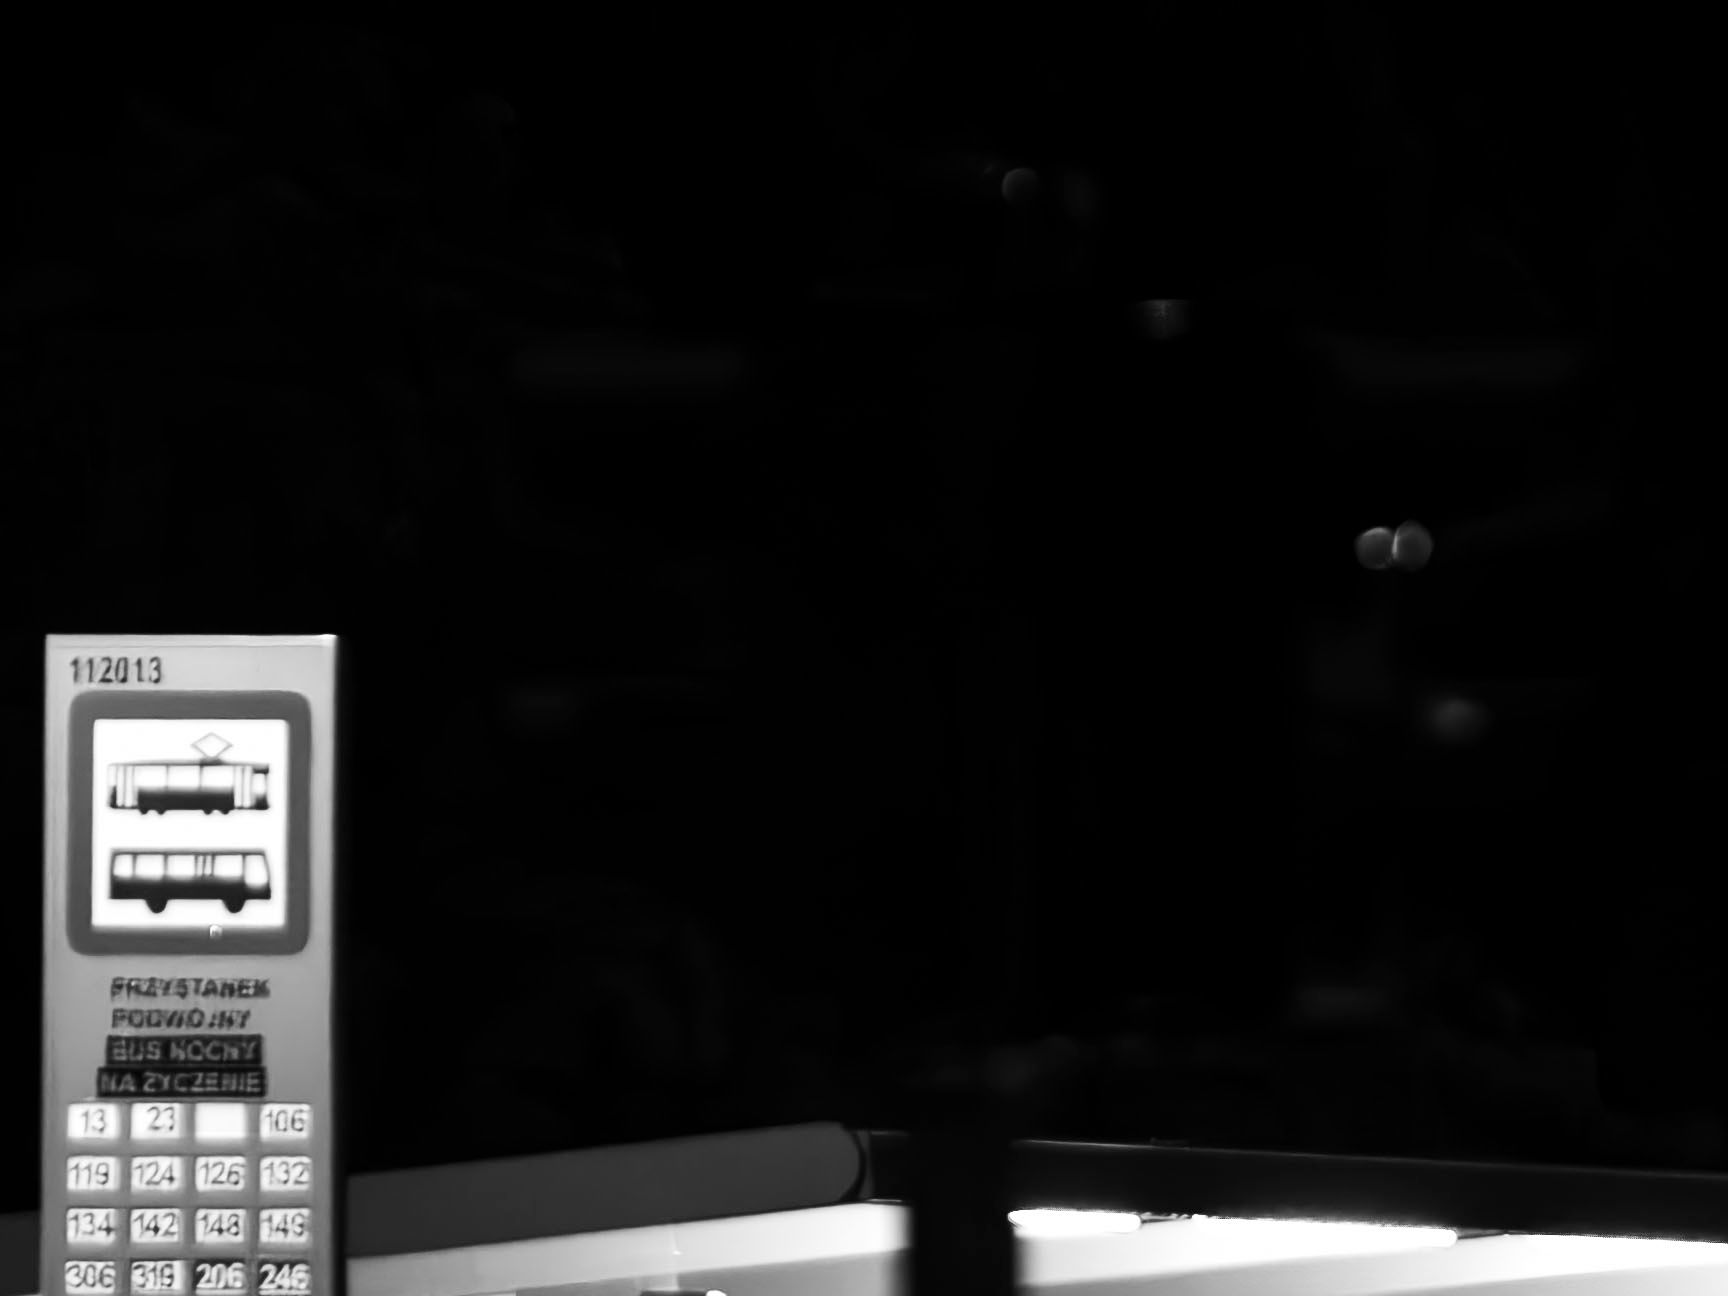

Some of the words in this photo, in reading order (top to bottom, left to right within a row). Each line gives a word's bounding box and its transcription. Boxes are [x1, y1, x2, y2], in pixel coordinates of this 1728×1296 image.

[69, 655, 164, 684] 112013
[111, 1040, 161, 1062] BUS
[100, 1071, 137, 1093] NA
[80, 1107, 109, 1134] 13
[146, 1105, 176, 1131] 23
[264, 1108, 307, 1133] 106
[132, 1159, 176, 1186] 124
[198, 1160, 246, 1186] 126
[263, 1159, 310, 1186] 132
[68, 1212, 114, 1238] 134
[132, 1212, 178, 1239] 142
[196, 1212, 241, 1238] 148
[65, 1263, 116, 1288] 306
[195, 1262, 248, 1288] 206
[259, 1263, 311, 1290] 246
